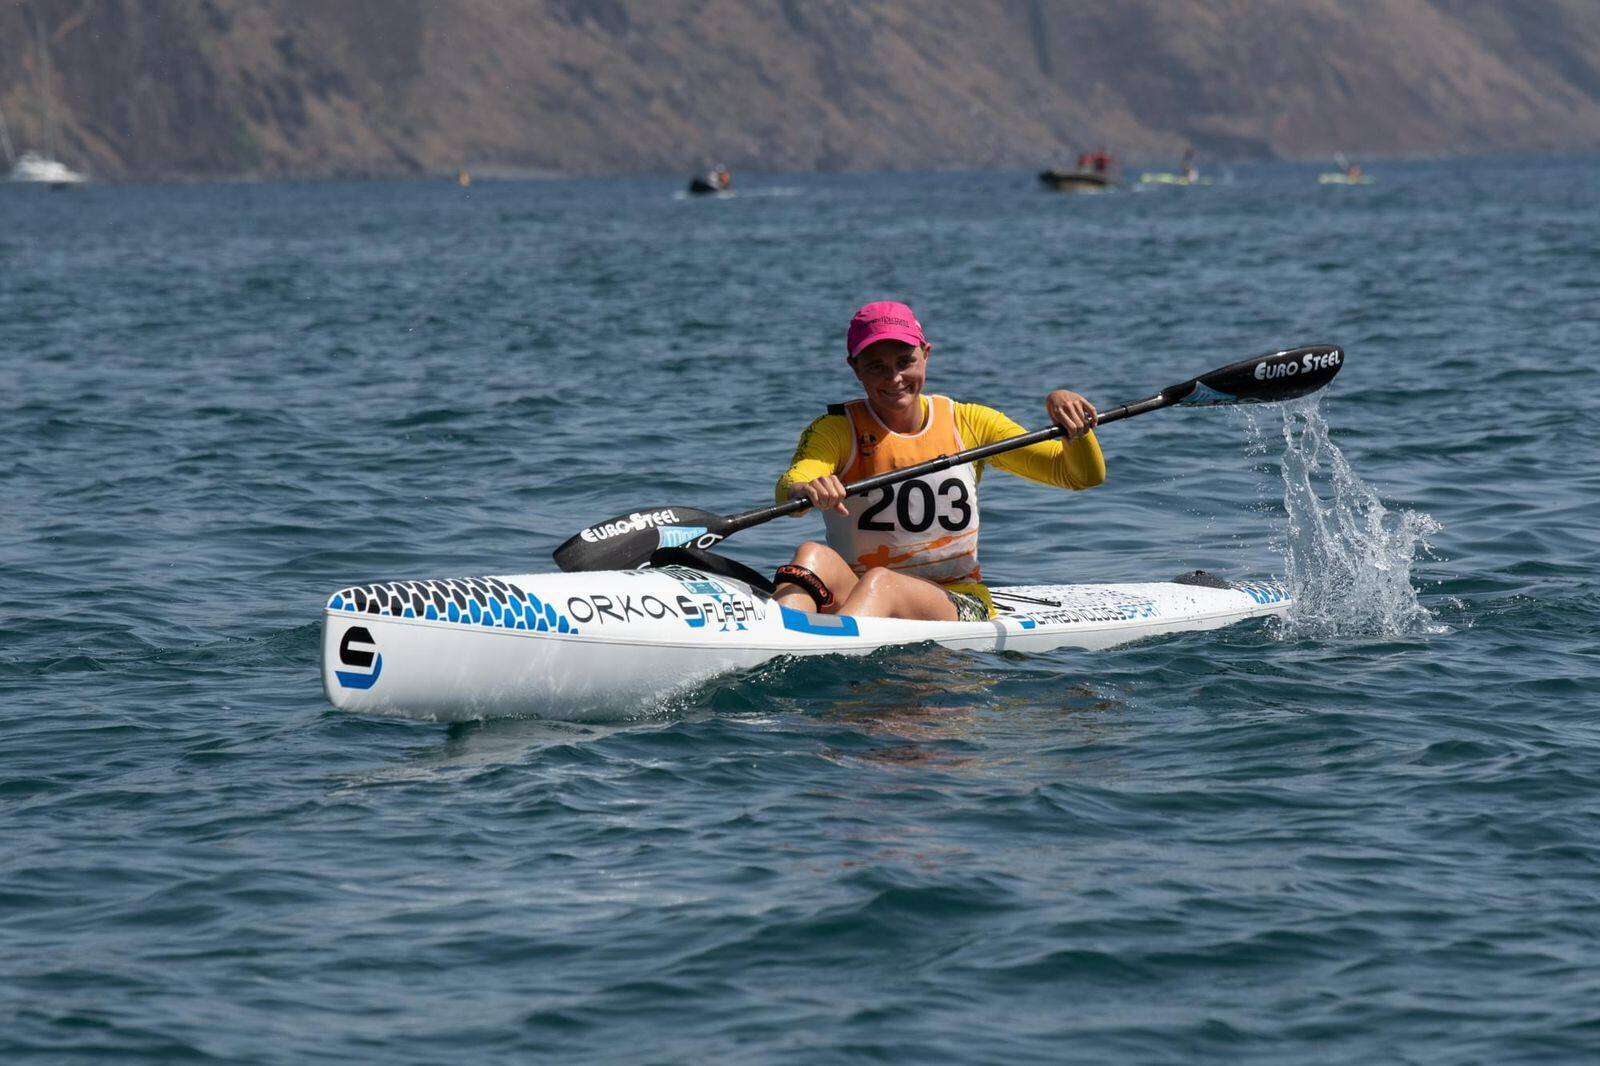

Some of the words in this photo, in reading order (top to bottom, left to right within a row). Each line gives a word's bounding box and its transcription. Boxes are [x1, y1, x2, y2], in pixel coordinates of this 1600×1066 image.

[1254, 362, 1299, 381] EURO
[1300, 350, 1342, 374] STEEL
[857, 477, 972, 533] 203
[580, 522, 631, 543] EURO
[629, 509, 680, 532] STEEL
